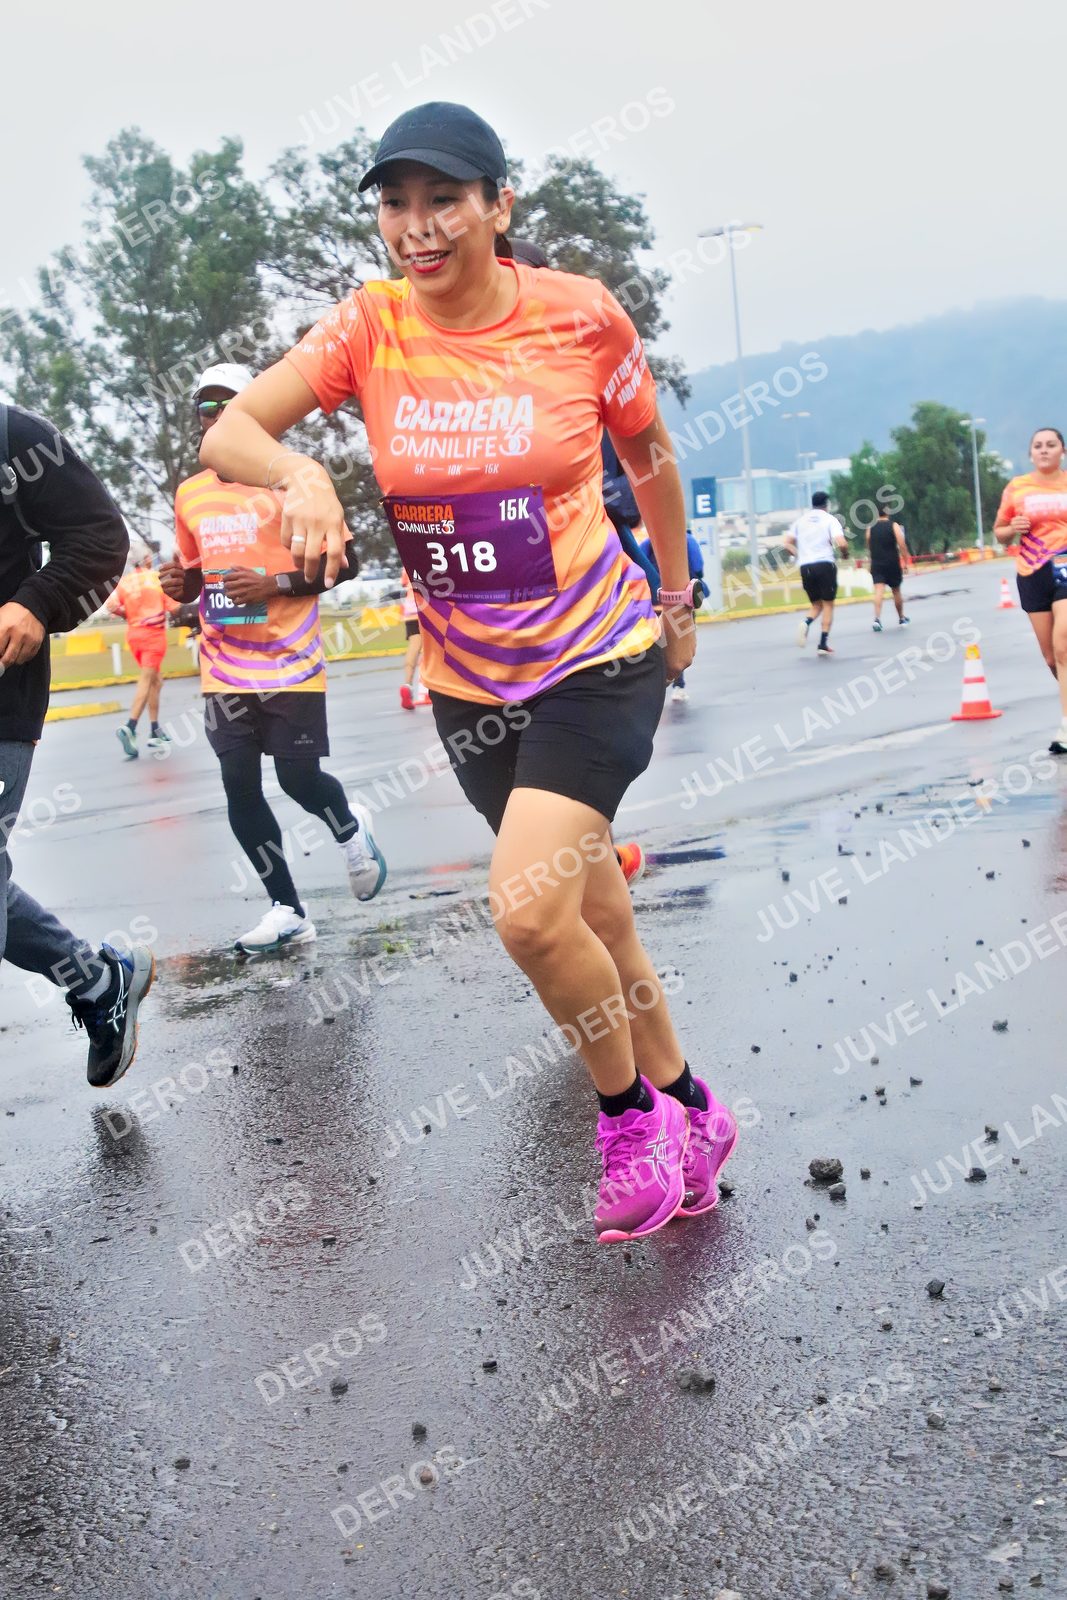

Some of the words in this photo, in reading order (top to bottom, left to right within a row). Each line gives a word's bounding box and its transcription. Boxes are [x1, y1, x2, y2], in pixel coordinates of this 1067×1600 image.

[393, 394, 534, 432] CARRERA
[390, 434, 497, 459] OMNILIFE
[393, 504, 455, 522] CARRERA
[499, 497, 530, 522] 15K
[696, 494, 712, 514] E
[397, 521, 442, 535] OMNILIFE
[426, 541, 497, 573] 318
[208, 592, 247, 609] 106
